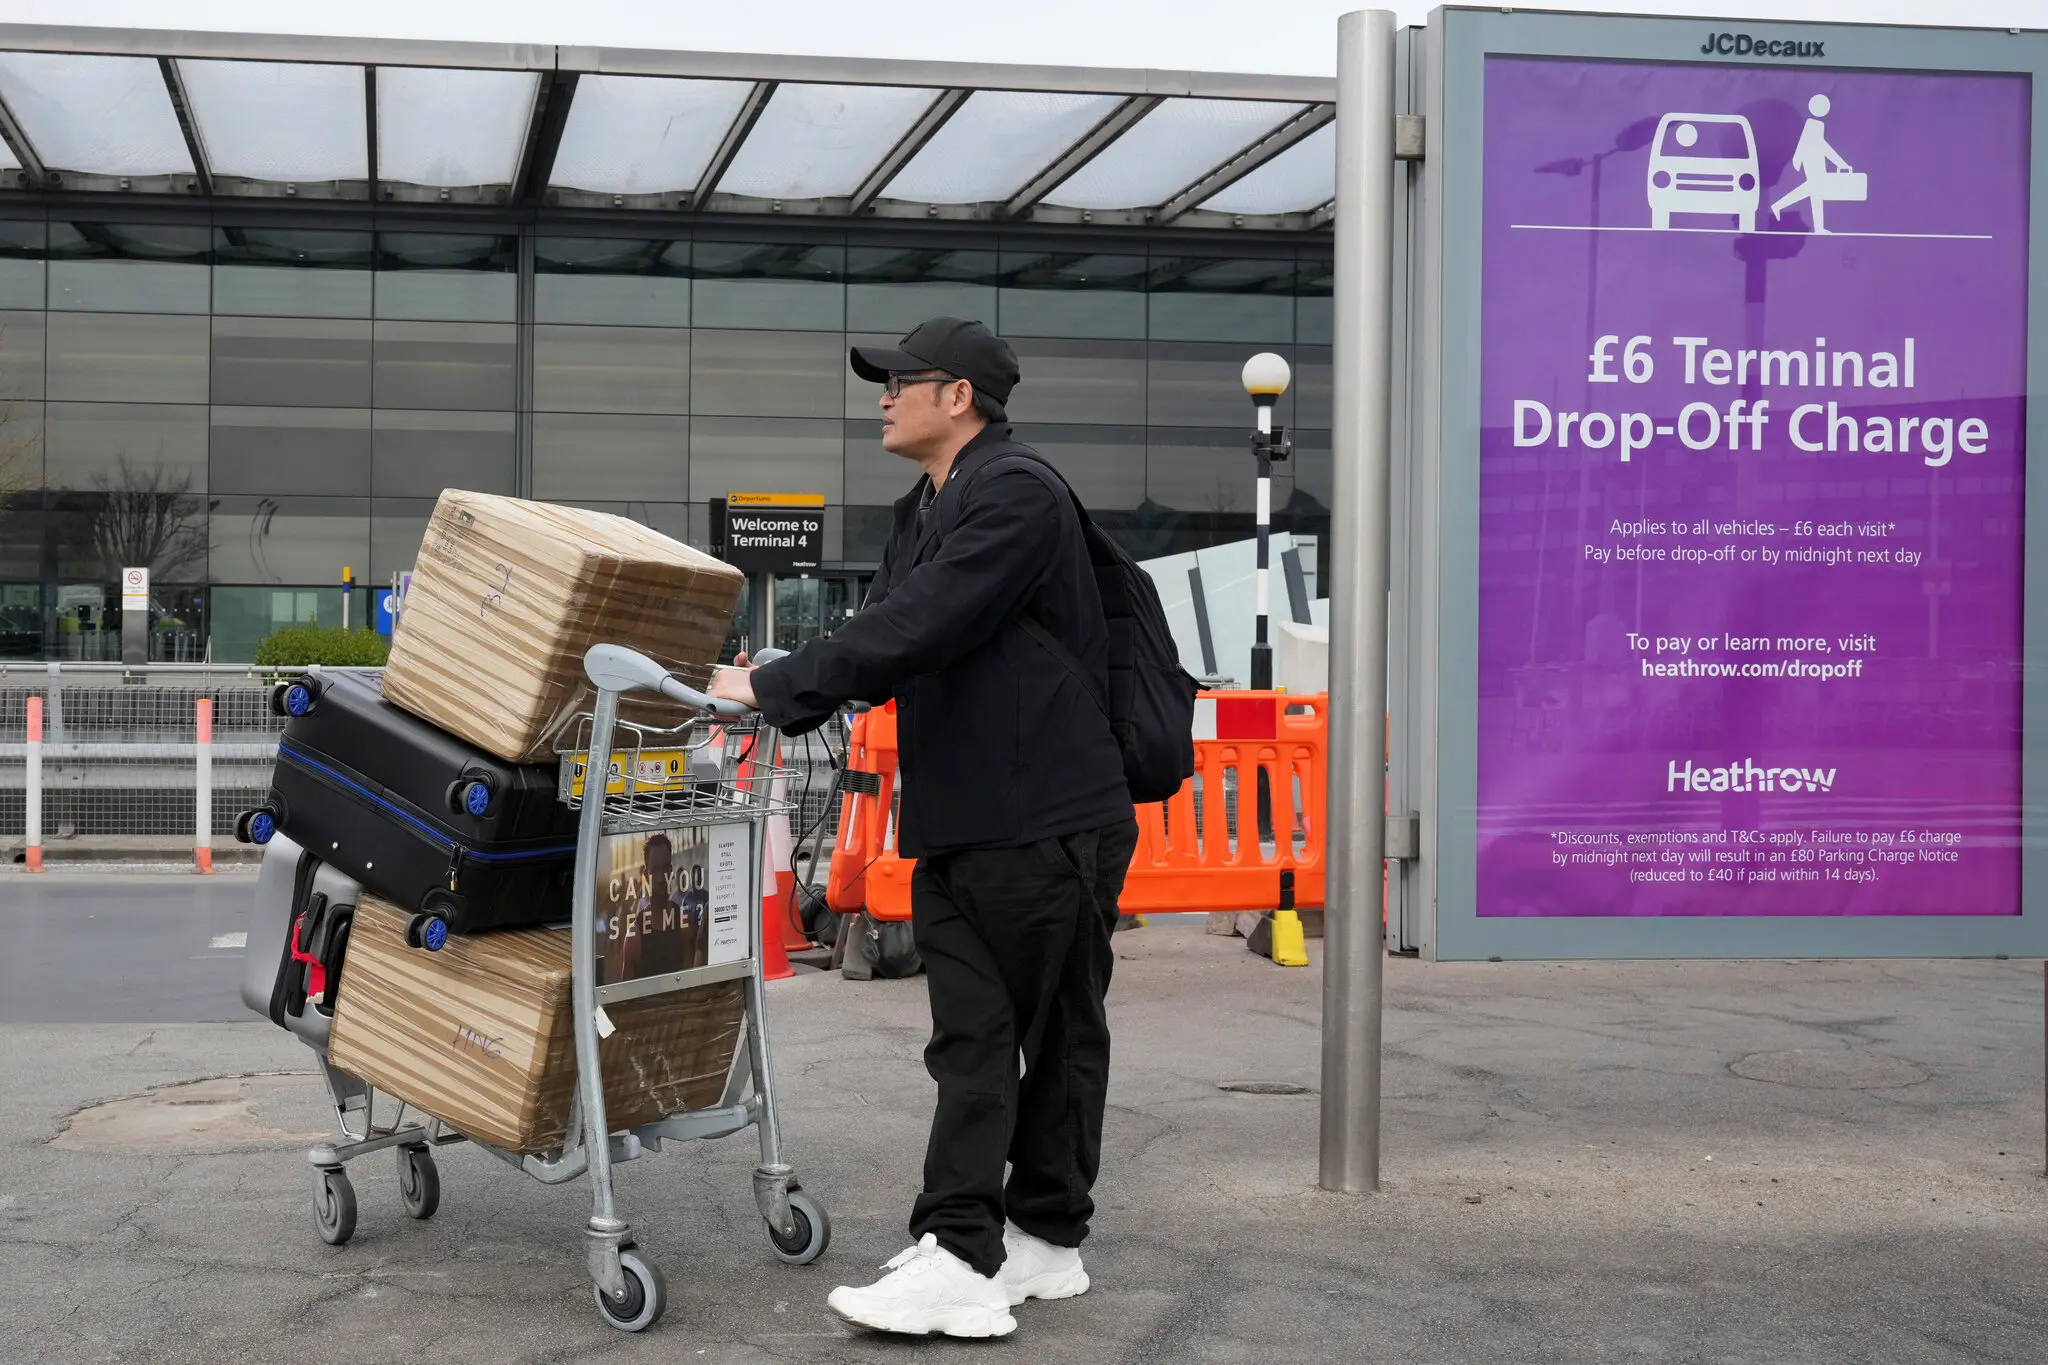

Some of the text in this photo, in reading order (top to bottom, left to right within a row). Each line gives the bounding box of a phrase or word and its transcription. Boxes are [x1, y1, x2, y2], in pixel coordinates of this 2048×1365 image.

[1701, 33, 1826, 57] JCDecaux
[1587, 334, 1915, 388] £6 Terminal
[1513, 399, 1989, 467] Drop-Off Charge
[731, 518, 819, 532] Welcome to
[1609, 518, 1667, 538] Applies
[1670, 520, 1688, 535] to
[1692, 519, 1710, 535] all
[1713, 519, 1775, 536] vehicles
[1793, 520, 1813, 536] £6
[1817, 520, 1853, 537] each
[731, 534, 808, 548] Terminal 4
[1584, 543, 1922, 568] Pay before drop-off or by midnight next day
[1625, 632, 1877, 656] To pay or learn more, visit
[1641, 658, 1863, 682] heathrow.com/dropoff
[1667, 757, 1837, 793] Heathrow
[1627, 829, 1699, 846] exemptions
[1701, 829, 1727, 844] and
[1730, 829, 1766, 844] T&Cs
[1769, 829, 1807, 847] apply.
[1811, 829, 1852, 844] Failure
[1855, 831, 1869, 844] to
[1871, 832, 1896, 847] pay
[1899, 829, 1916, 843] £6
[1918, 829, 1962, 847] charge
[1552, 847, 1959, 867] by midnight next day will result in an £80 Parking Charge Notice
[609, 867, 705, 903] CAN YOU
[1630, 867, 1879, 884] (reduced to £40 if paid within 14 days).
[609, 903, 704, 941] SEE ME?
